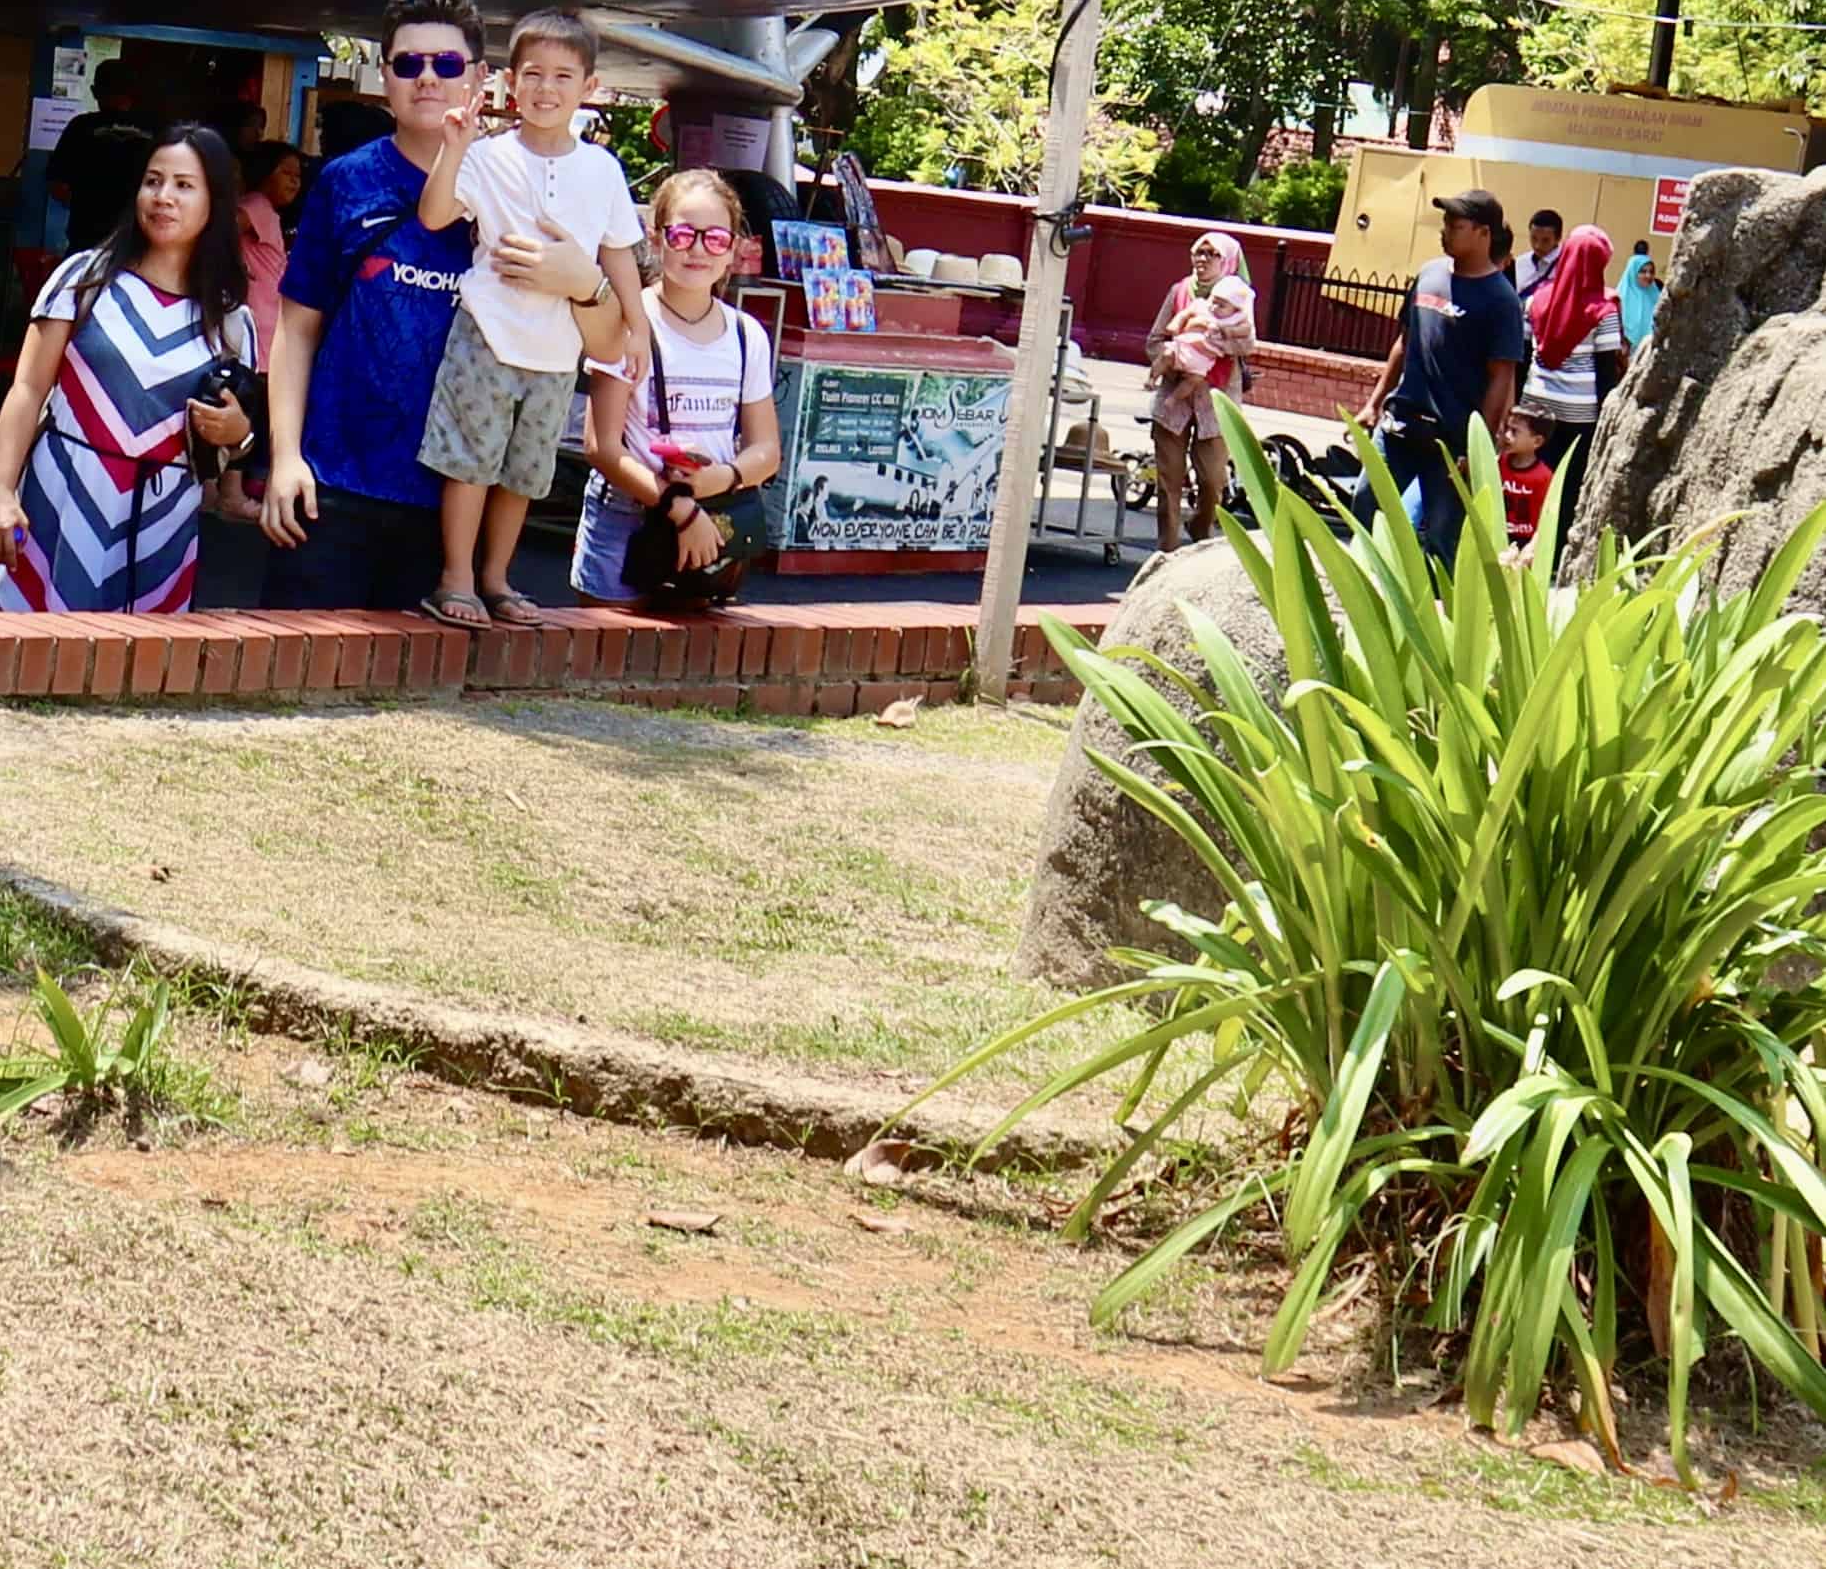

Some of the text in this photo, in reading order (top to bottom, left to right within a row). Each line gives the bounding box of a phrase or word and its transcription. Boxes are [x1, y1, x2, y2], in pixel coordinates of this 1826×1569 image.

[812, 521, 841, 538] NOW
[844, 521, 911, 539] EVERYONE
[914, 522, 938, 539] CAN
[941, 523, 957, 540] BE
